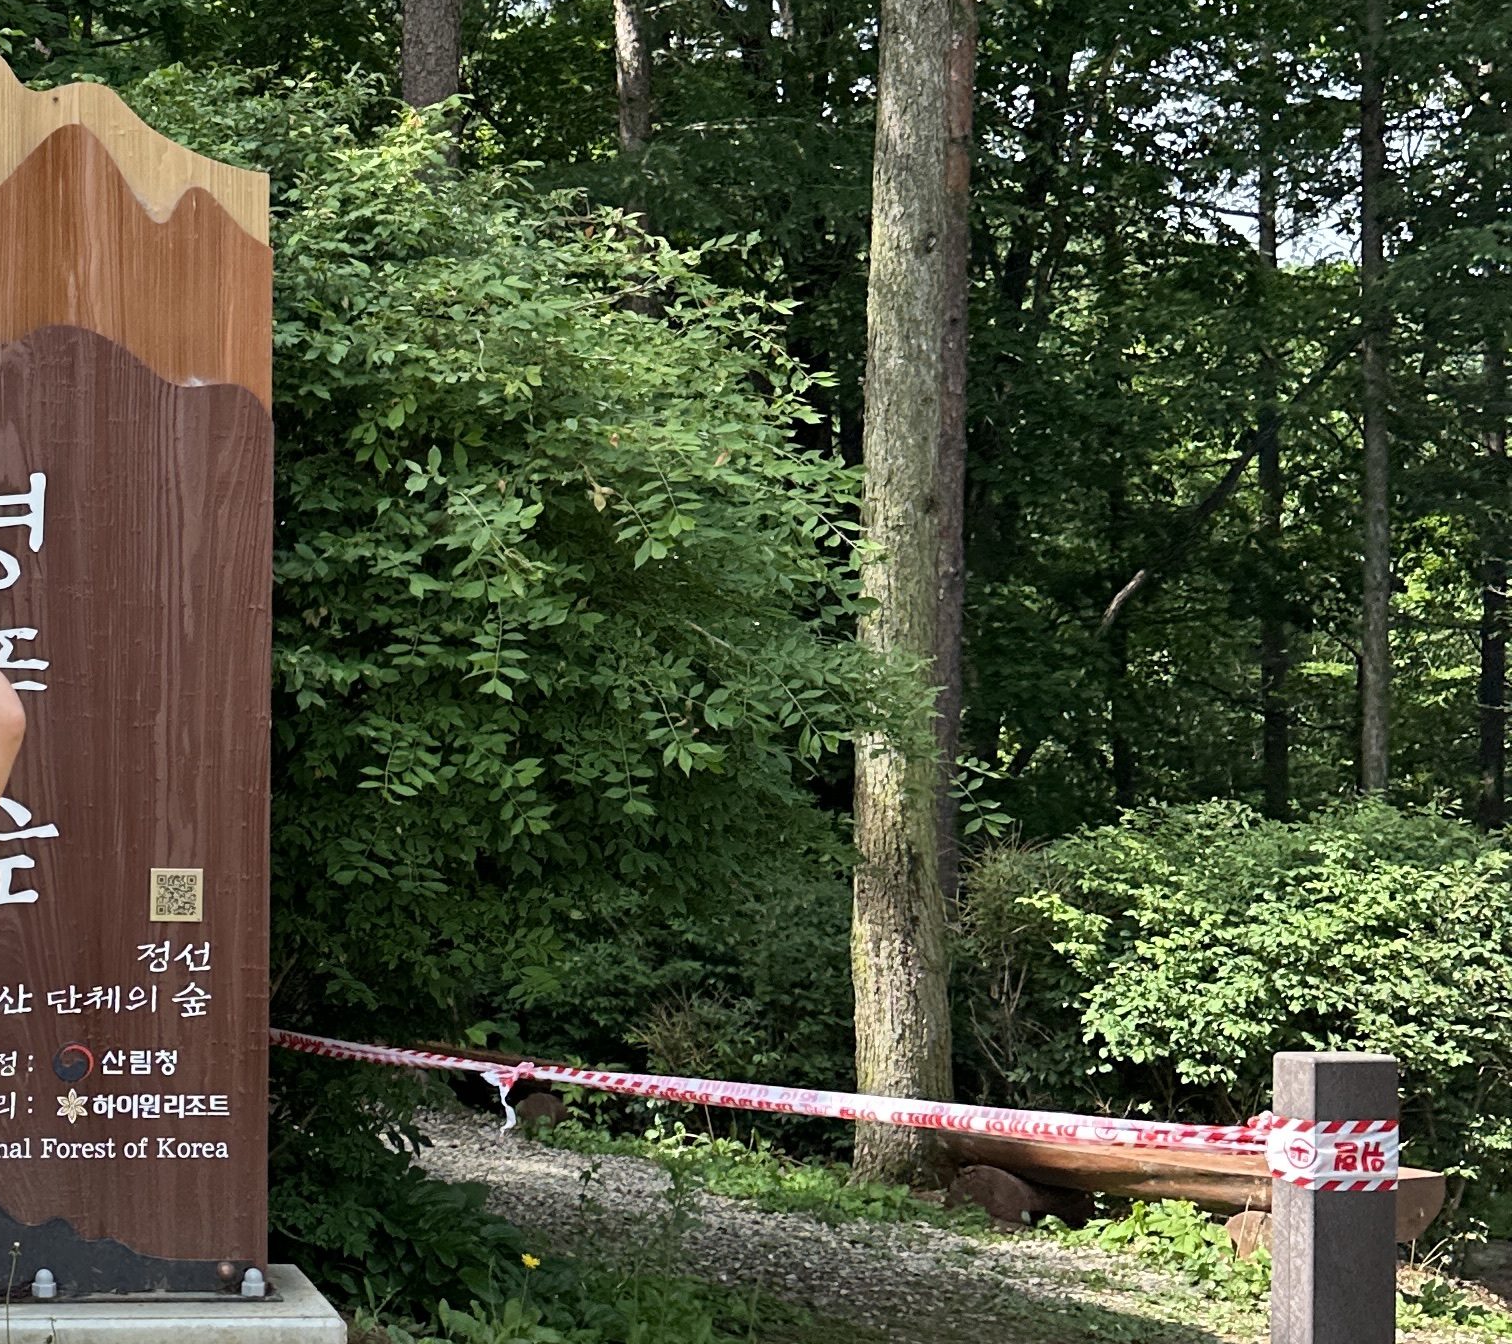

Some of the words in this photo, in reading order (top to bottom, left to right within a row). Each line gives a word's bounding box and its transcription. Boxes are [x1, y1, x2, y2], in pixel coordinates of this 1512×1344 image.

[136, 940, 212, 973] 정선
[46, 984, 158, 1015] 단체의
[171, 981, 212, 1018] 숲
[101, 1049, 178, 1076] 산림청
[92, 1093, 231, 1119] 하이원리조트
[40, 1137, 117, 1159] Forest
[123, 1136, 149, 1159] of
[156, 1137, 229, 1159] Korea
[1333, 1141, 1385, 1173] 위험
